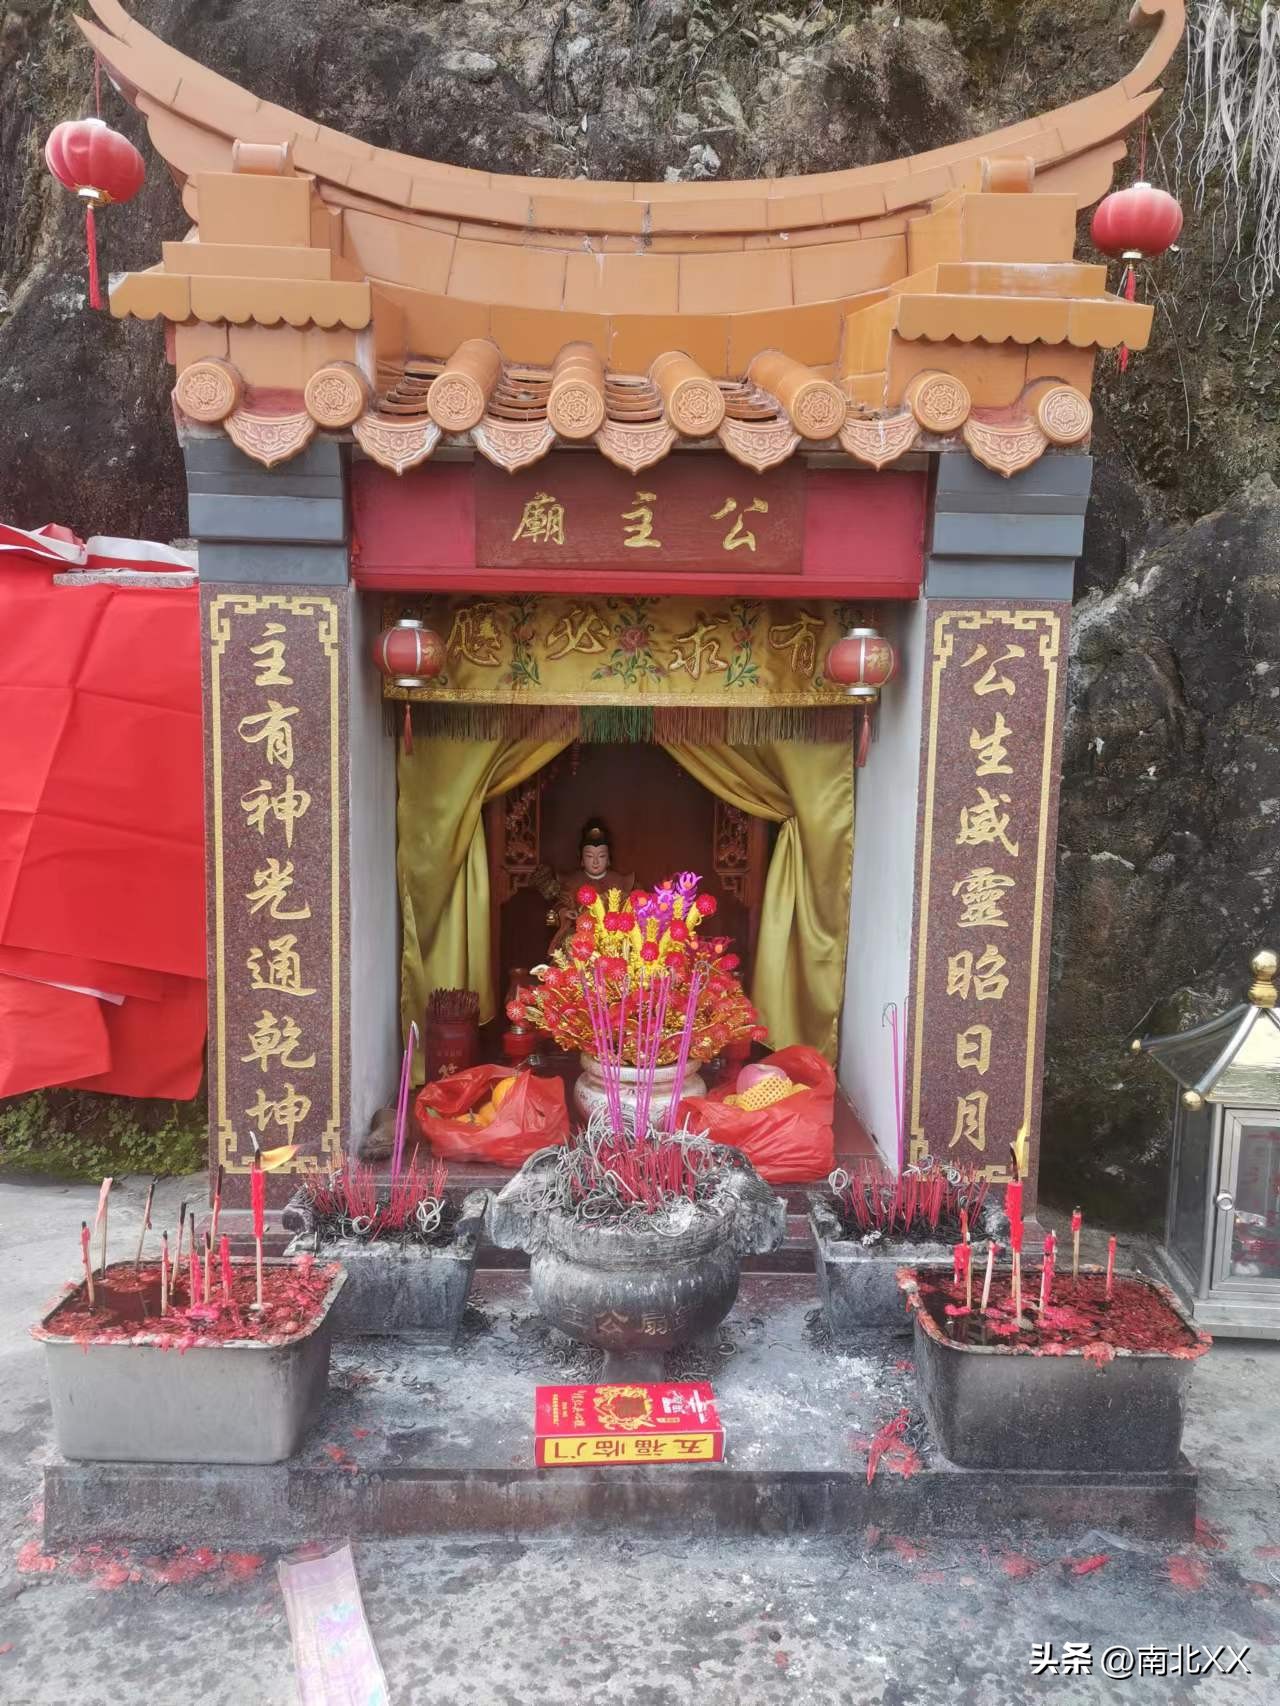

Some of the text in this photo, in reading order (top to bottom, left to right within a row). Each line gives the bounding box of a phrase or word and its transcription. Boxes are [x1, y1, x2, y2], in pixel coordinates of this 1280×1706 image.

[512, 492, 769, 552] 公主廟
[238, 622, 317, 1146] 主有神光通乾坤
[946, 644, 1026, 1151] 公生威靈昭日月
[554, 1437, 708, 1459] 五福临门
